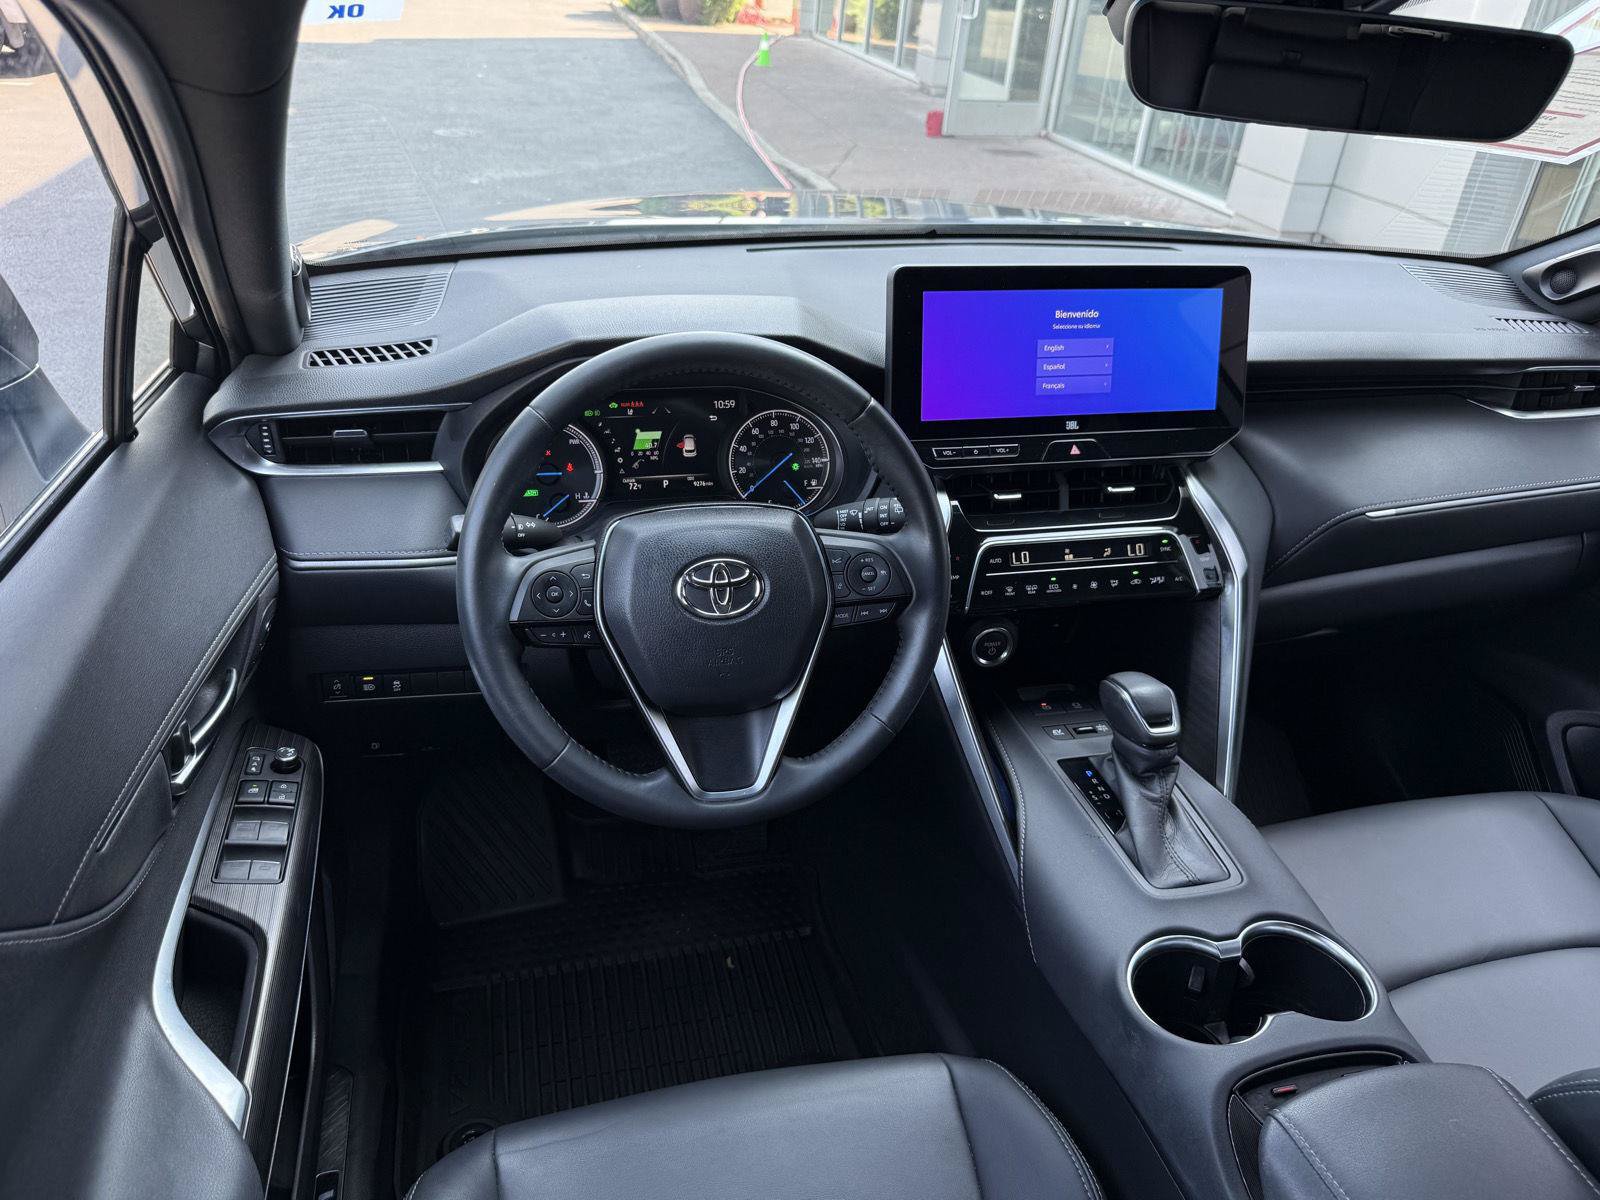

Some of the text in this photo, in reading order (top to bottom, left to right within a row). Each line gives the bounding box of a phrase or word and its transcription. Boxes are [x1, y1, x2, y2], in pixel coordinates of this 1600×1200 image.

[1055, 310, 1099, 319] Bienvenido
[1043, 363, 1066, 371] Español
[1042, 382, 1065, 390] Français
[713, 400, 735, 410] 10:59
[770, 419, 778, 427] 80
[1065, 421, 1079, 430] JBL
[751, 427, 759, 435] 60
[738, 466, 747, 474] 20
[663, 480, 669, 488] P
[1127, 543, 1144, 556] LO
[1012, 551, 1030, 565] LO
